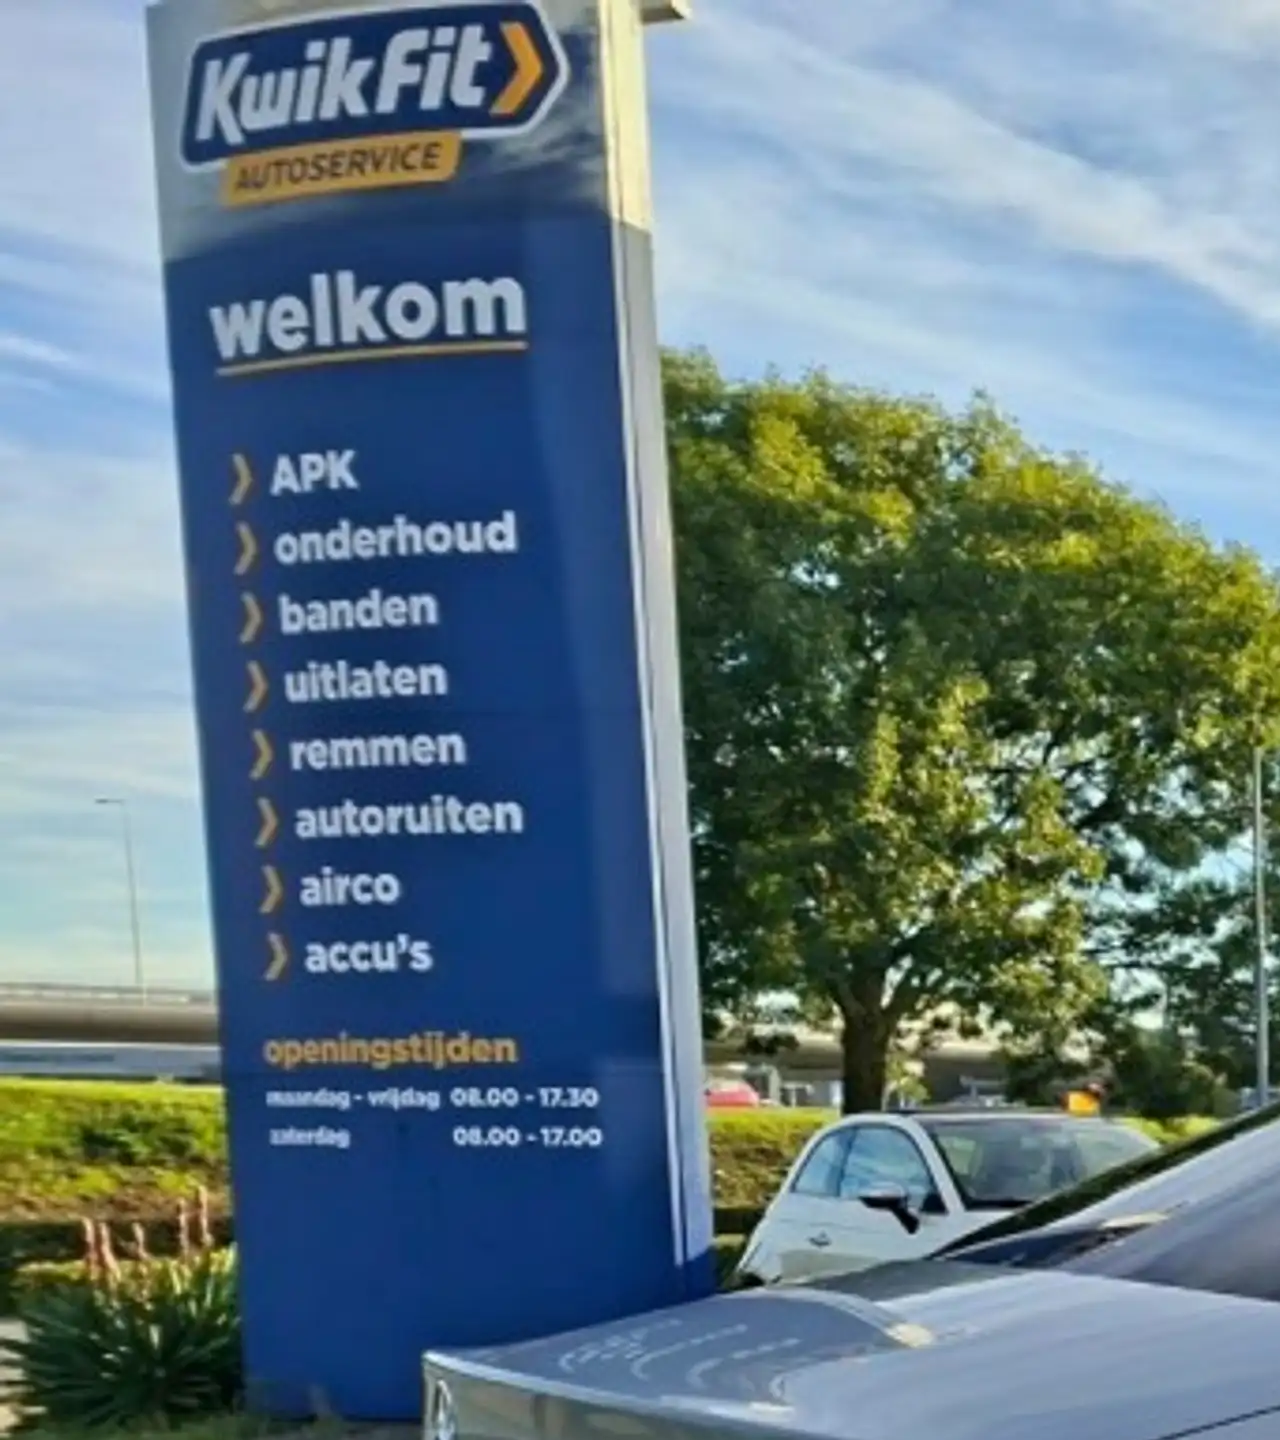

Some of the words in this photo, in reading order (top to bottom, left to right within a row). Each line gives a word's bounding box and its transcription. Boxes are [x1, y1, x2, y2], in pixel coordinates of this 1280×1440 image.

[234, 142, 441, 193] AUTOSERVICE
[209, 271, 526, 361] welkom
[269, 449, 360, 497] APK
[274, 510, 520, 565] onderhoud
[278, 588, 440, 635] banden
[285, 660, 449, 703] uitlaten
[290, 732, 467, 770] remmen
[295, 794, 524, 838] autoruiten
[300, 866, 401, 906] airco
[304, 934, 434, 973] accu's
[263, 1030, 519, 1070] openingstijden
[538, 1087, 600, 1108] 17.30
[540, 1126, 603, 1147] 17.00
